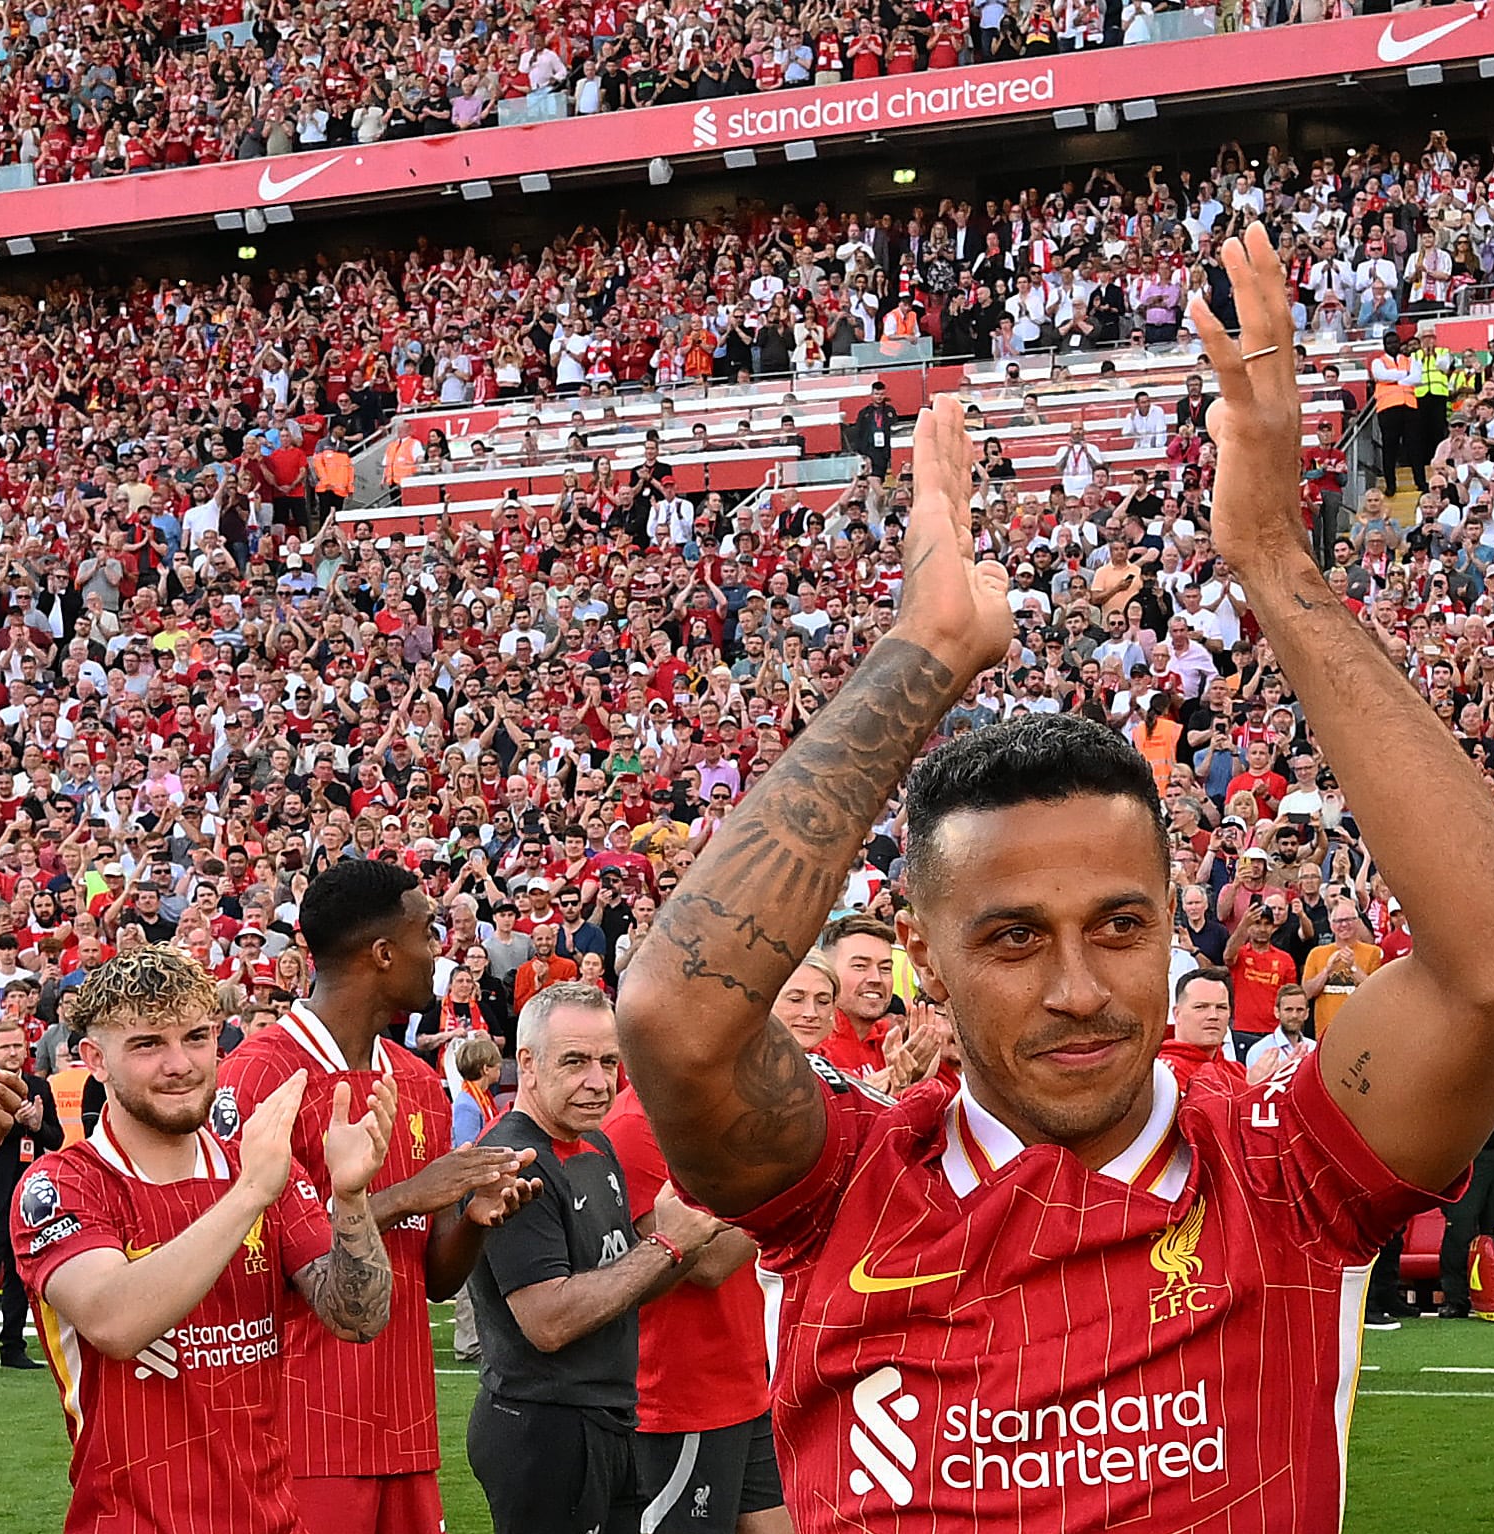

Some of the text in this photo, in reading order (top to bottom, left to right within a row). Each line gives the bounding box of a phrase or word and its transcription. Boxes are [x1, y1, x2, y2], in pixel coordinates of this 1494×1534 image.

[727, 69, 1053, 138] standard chartered
[445, 417, 470, 439] L7
[179, 1312, 274, 1347] standard
[182, 1334, 279, 1370] chartered
[943, 1379, 1208, 1444] standard
[941, 1426, 1225, 1490] chartered
